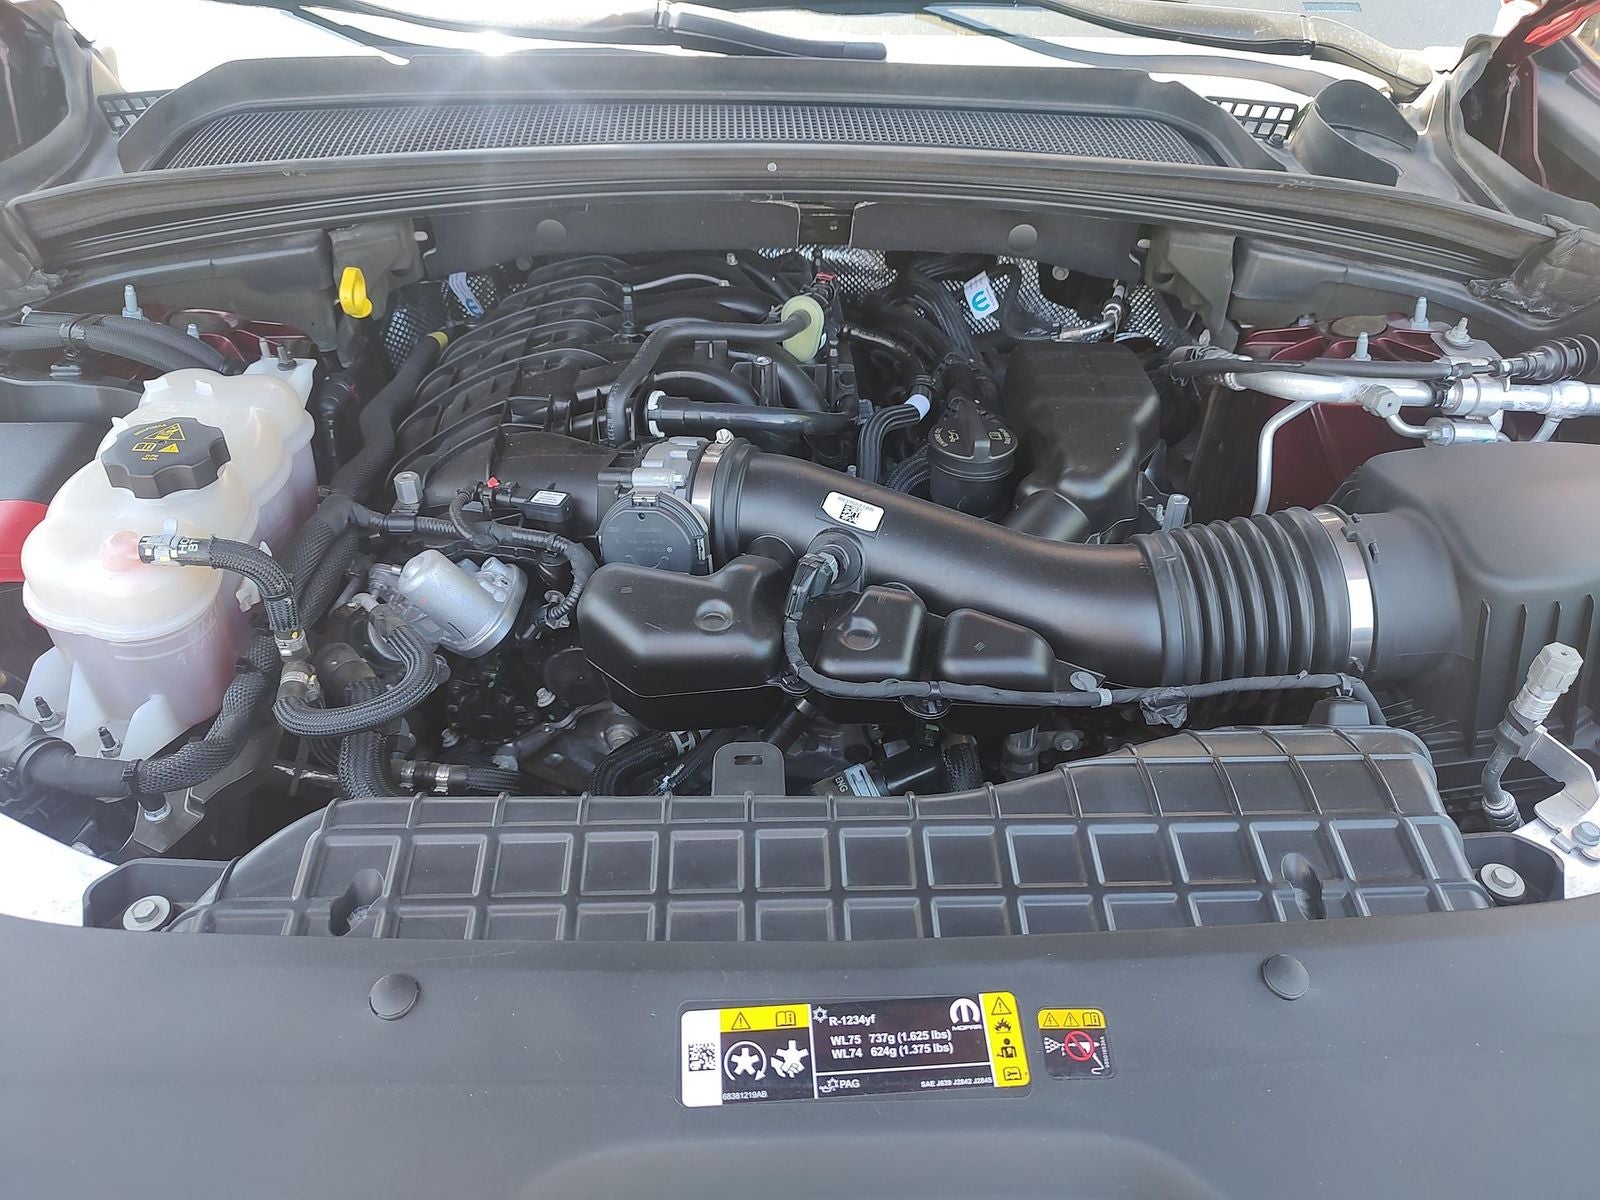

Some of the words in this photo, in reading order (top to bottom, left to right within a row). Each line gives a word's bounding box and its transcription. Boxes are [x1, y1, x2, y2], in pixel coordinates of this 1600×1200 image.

[835, 776, 848, 792] ENG
[829, 1014, 876, 1026] R-1234yf
[951, 1024, 983, 1032] MOPAR
[830, 1034, 862, 1046] WL75
[869, 1033, 896, 1044] 737g
[897, 1031, 930, 1044] (1.625
[931, 1029, 952, 1041] lbs)
[831, 1048, 863, 1059] WL74
[870, 1046, 897, 1058] 624g
[899, 1044, 931, 1057] (1.375
[933, 1042, 954, 1054] lbs)
[839, 1079, 860, 1089] PAG
[722, 1090, 768, 1100] 68381219AB
